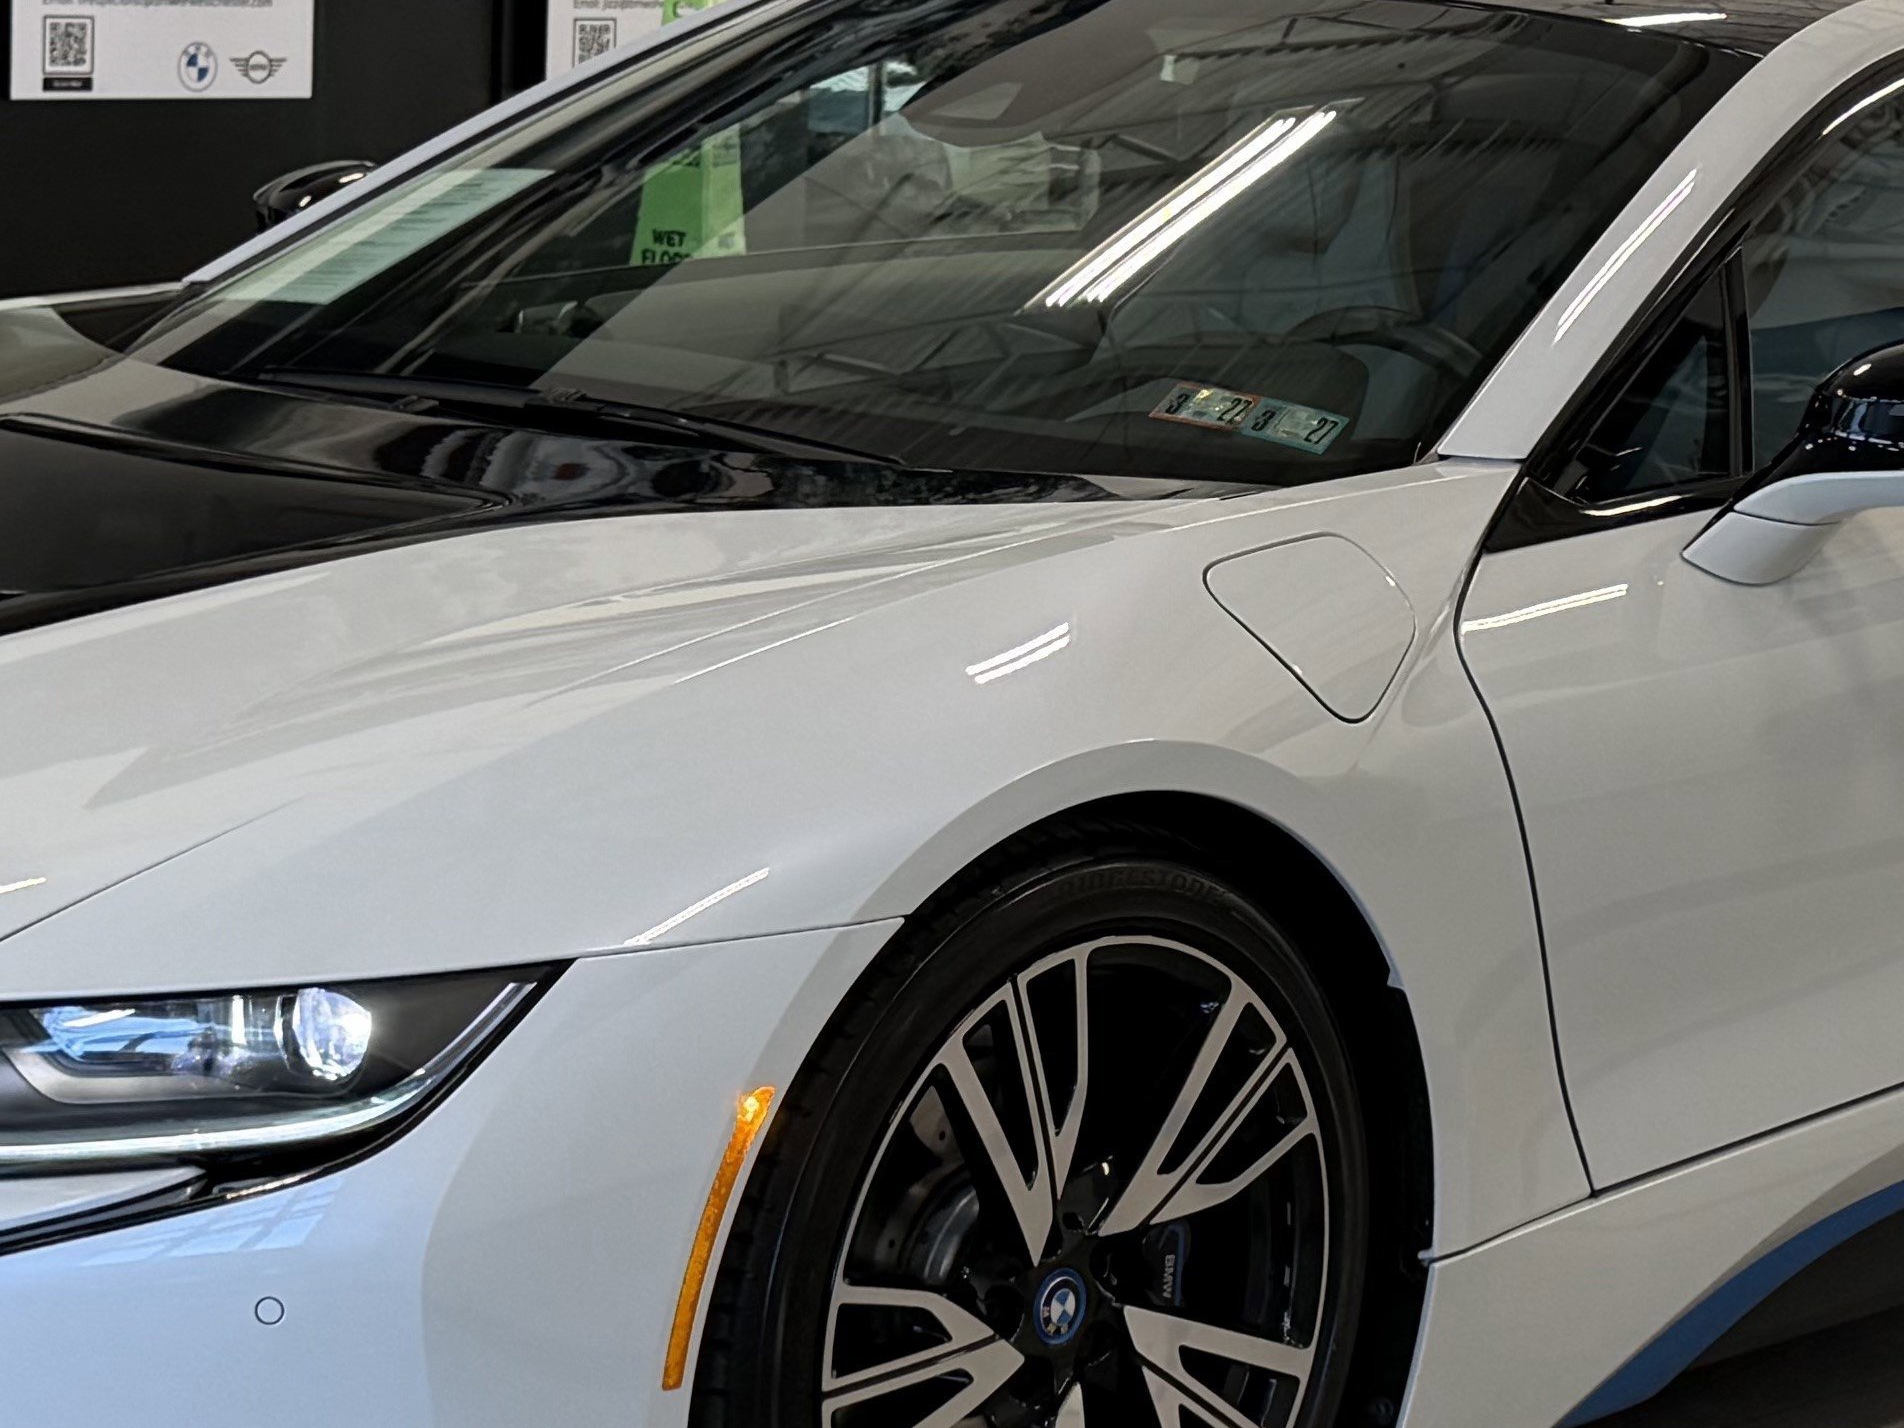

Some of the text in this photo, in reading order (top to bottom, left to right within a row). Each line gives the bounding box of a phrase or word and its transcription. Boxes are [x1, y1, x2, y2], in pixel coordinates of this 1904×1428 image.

[652, 228, 687, 247] WET
[1251, 409, 1339, 445] 3 27
[1162, 1254, 1176, 1299] BMW
